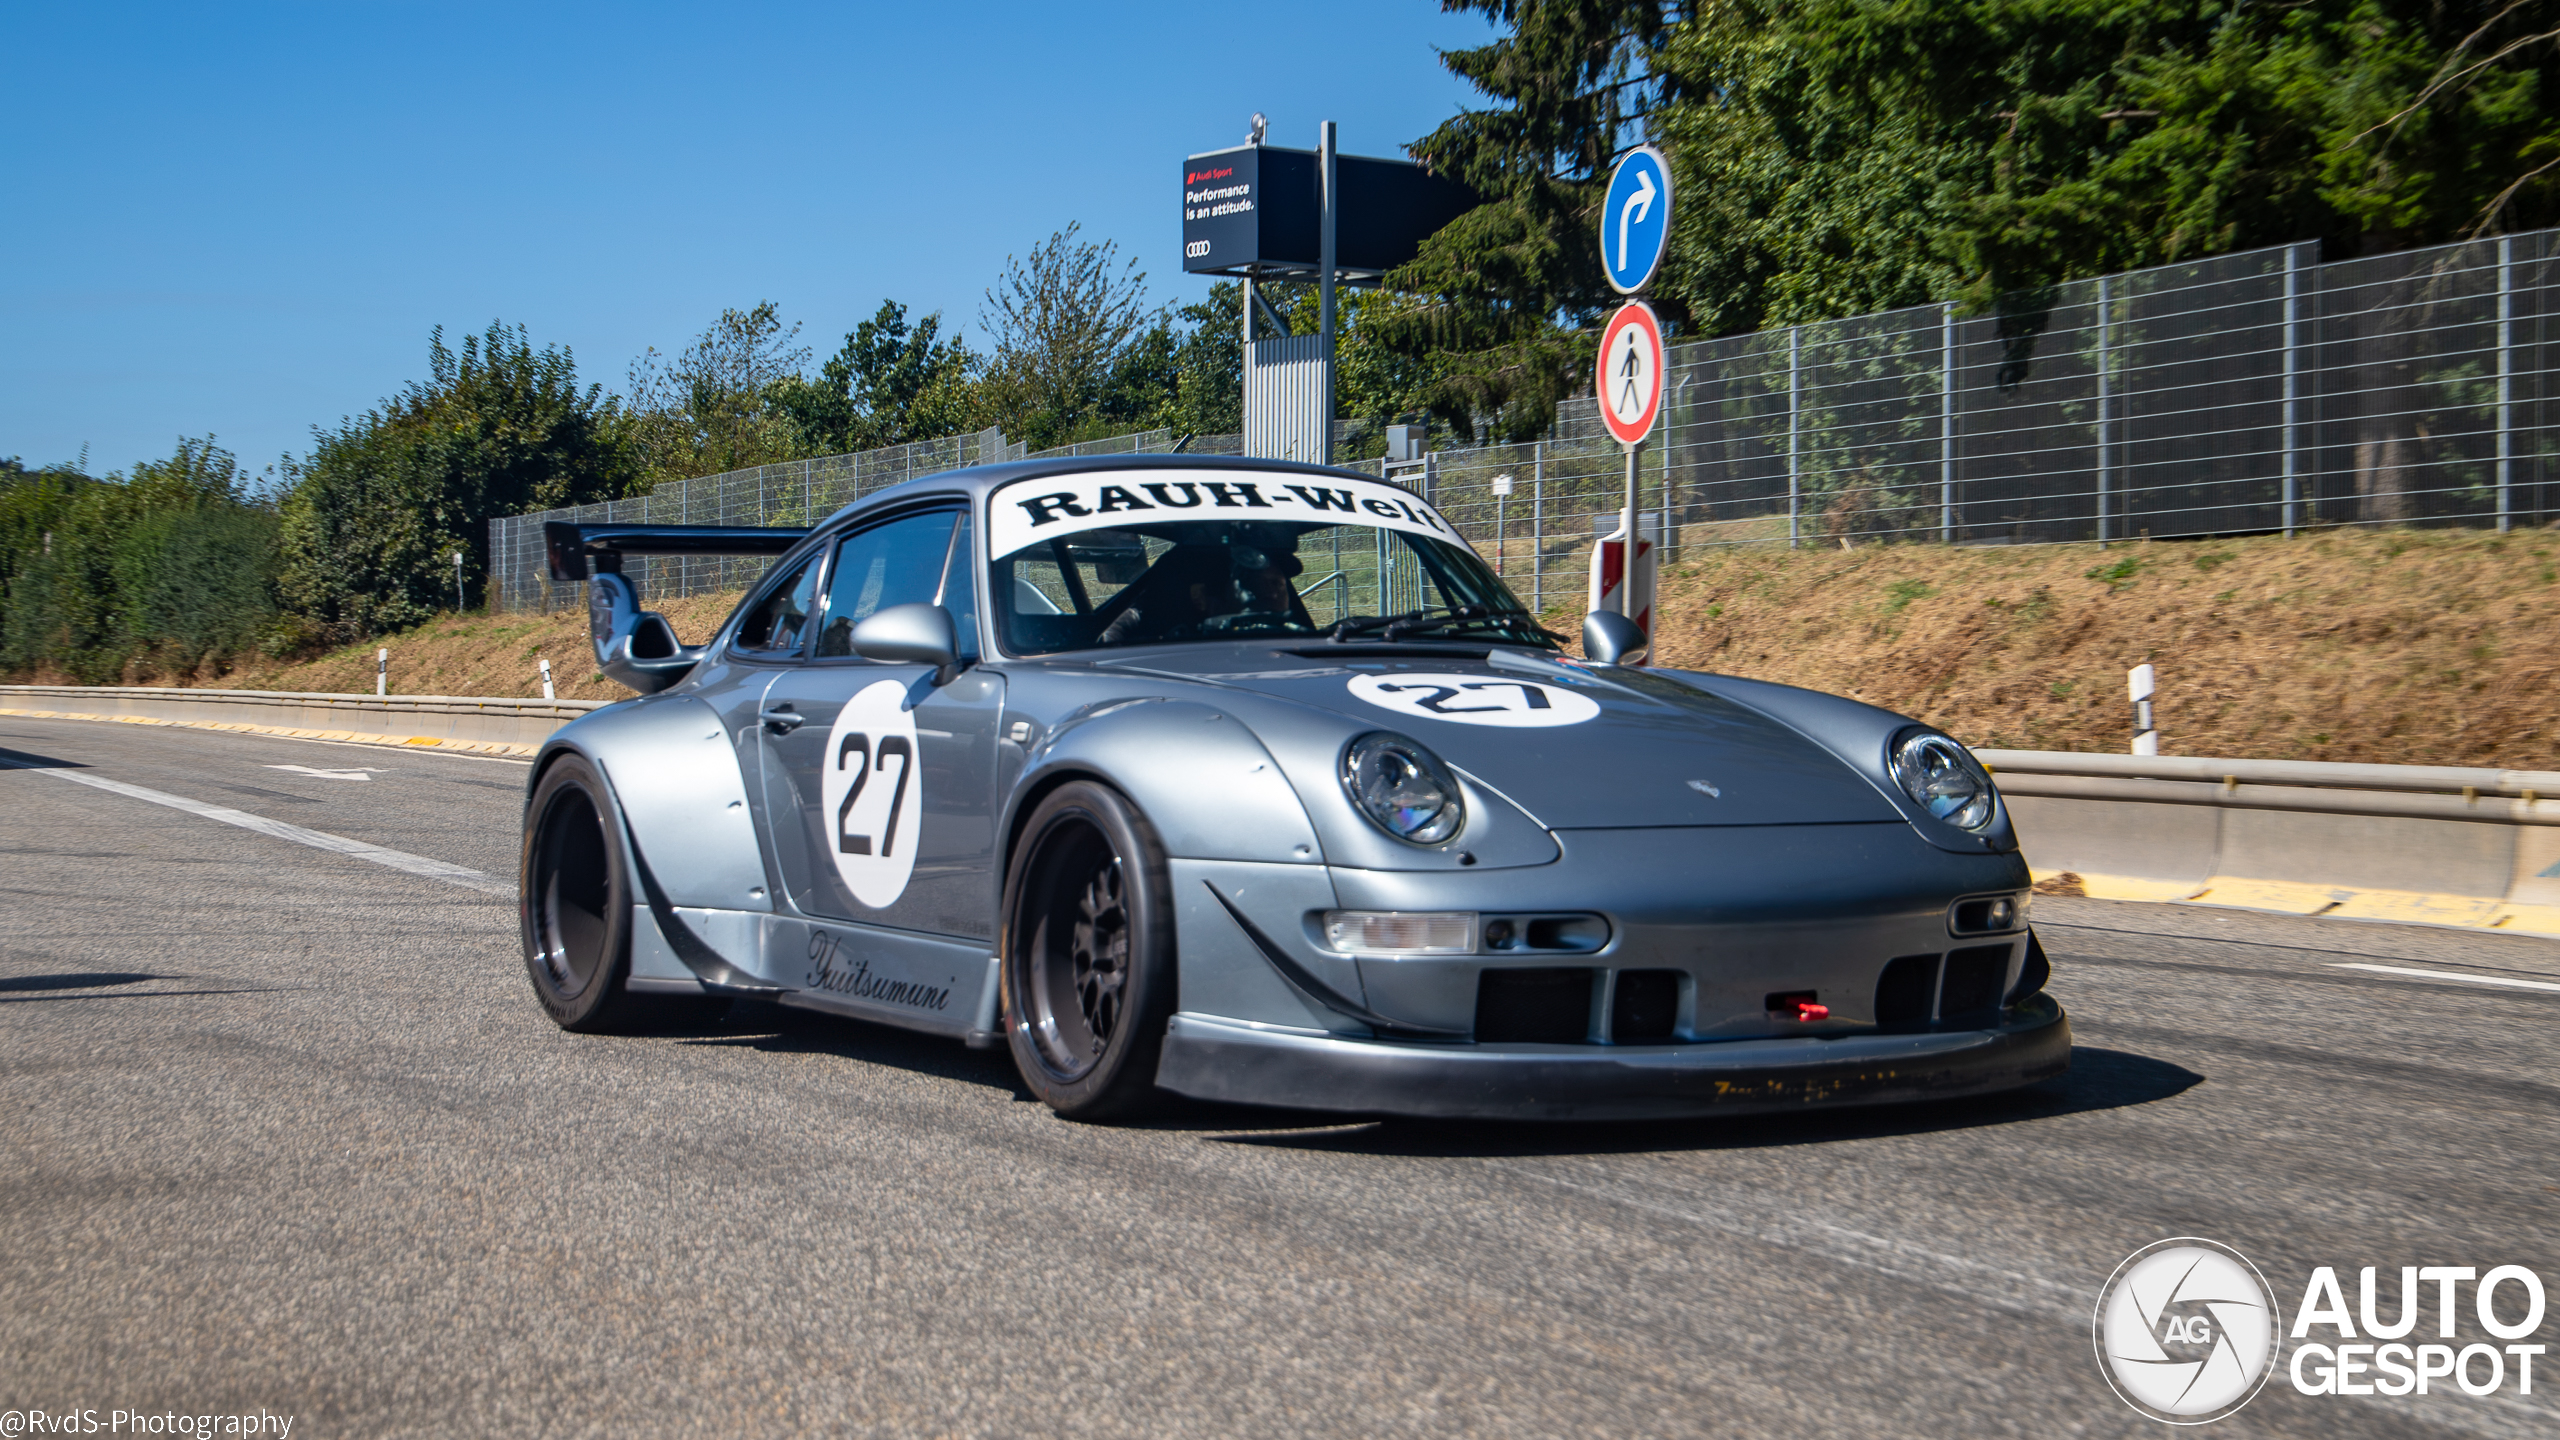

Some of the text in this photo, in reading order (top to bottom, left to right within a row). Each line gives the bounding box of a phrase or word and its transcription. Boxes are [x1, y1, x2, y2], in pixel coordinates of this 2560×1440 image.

[1195, 167, 1232, 181] Audi Sport
[1186, 184, 1250, 204] Performance
[1186, 198, 1255, 221] is an attitude.
[1016, 482, 1446, 533] RAUH-Welt
[1377, 682, 1552, 714] 27
[838, 732, 912, 857] 27
